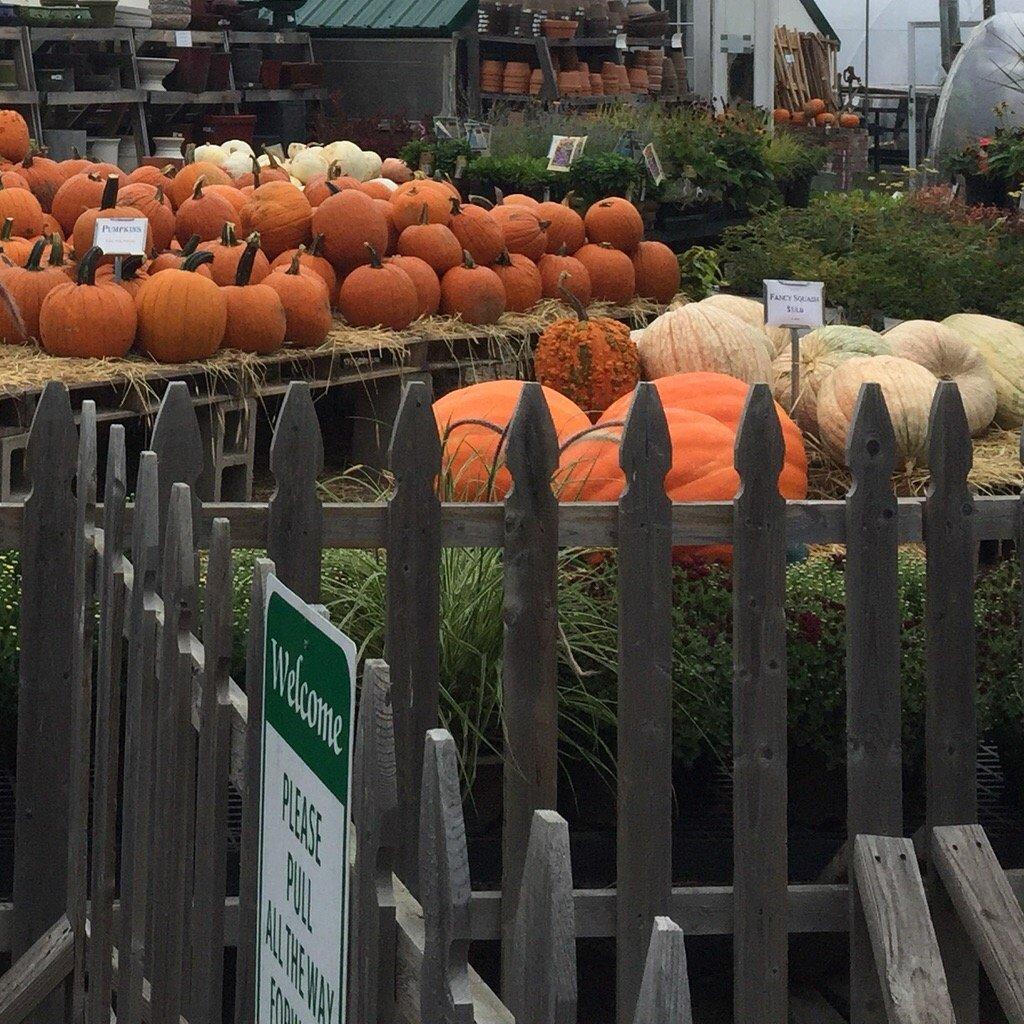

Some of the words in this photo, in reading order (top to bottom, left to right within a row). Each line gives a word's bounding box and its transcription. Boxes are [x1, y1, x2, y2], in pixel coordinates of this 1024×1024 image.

[102, 225, 142, 233] PUMPKINS
[770, 293, 792, 302] FANCY
[271, 638, 343, 756] Welcome
[282, 772, 322, 867] PLEASE
[287, 851, 313, 934] PULL
[265, 899, 283, 968] ALL
[286, 924, 305, 1000] THE
[307, 955, 335, 1024] WAY
